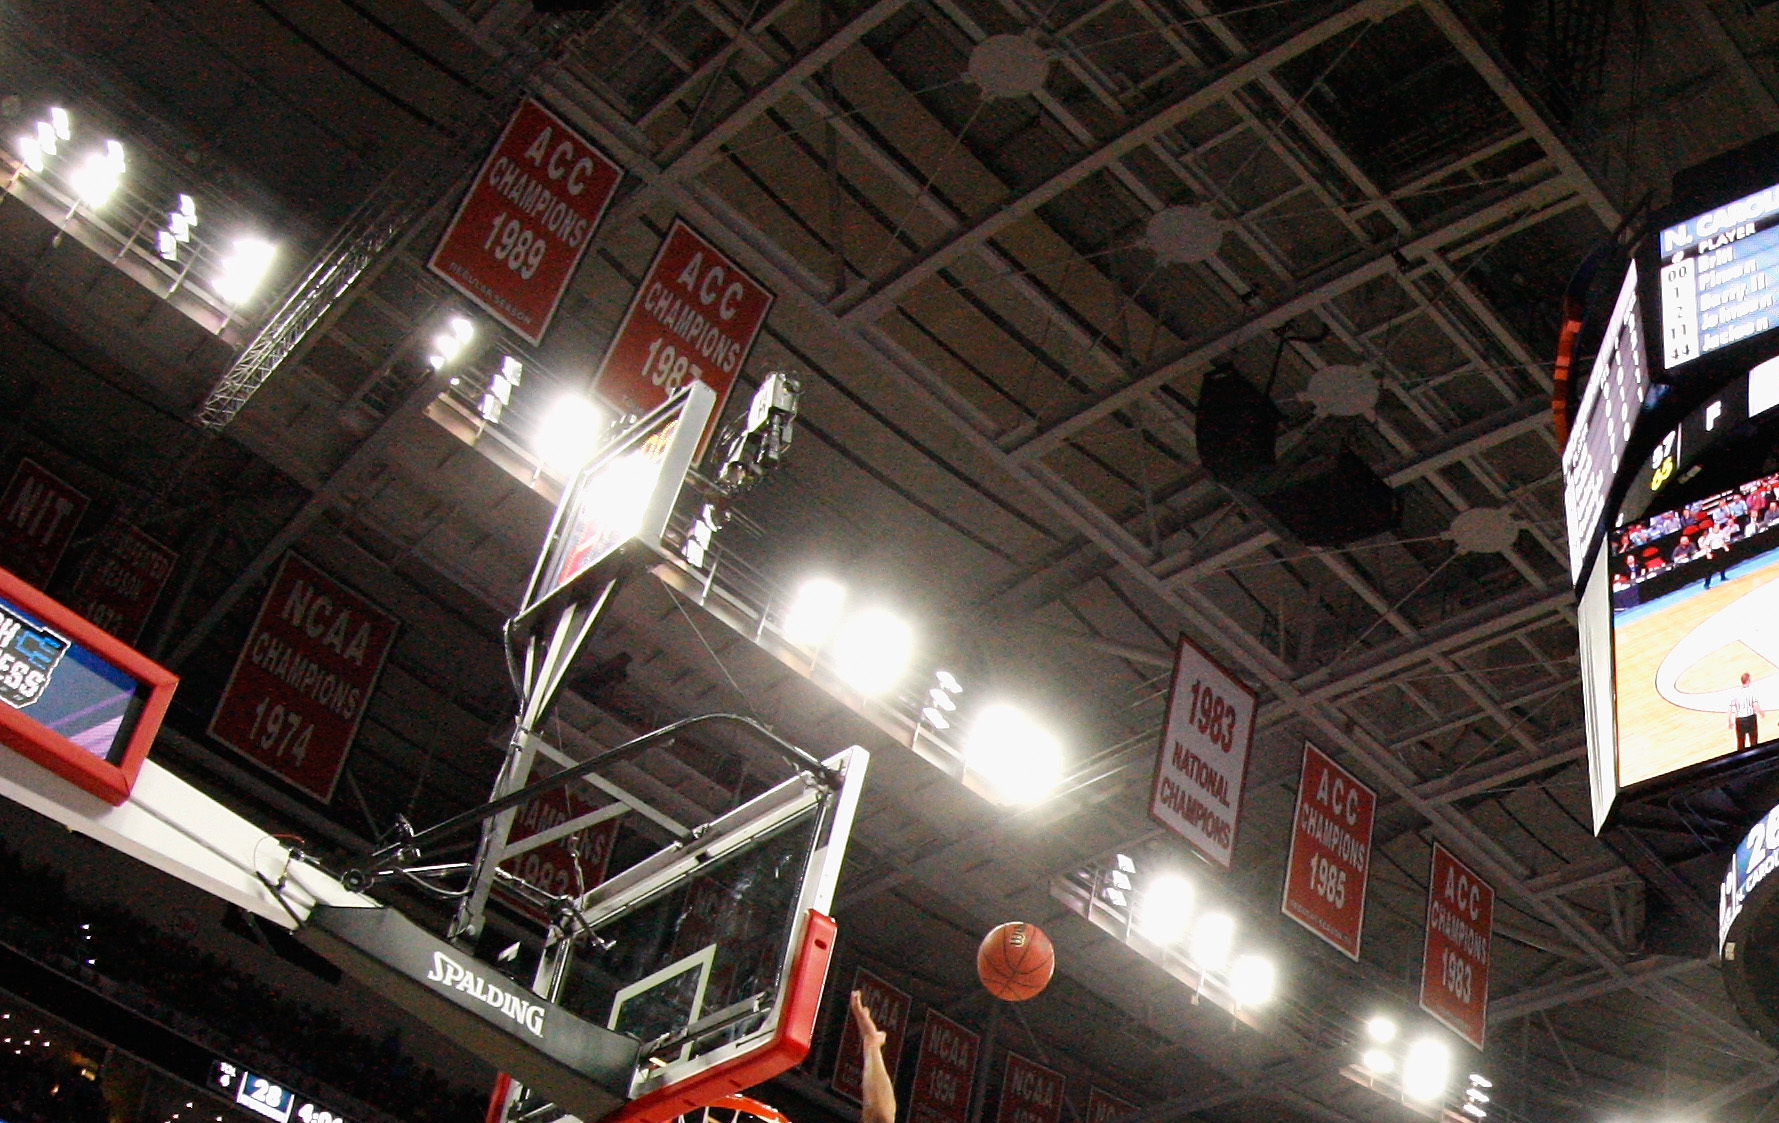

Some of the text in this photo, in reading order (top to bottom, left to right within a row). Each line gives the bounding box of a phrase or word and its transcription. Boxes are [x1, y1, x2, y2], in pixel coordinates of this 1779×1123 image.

[522, 125, 595, 197] ACC
[487, 155, 589, 249] CHAMPIONS
[483, 211, 547, 281] 1989
[1698, 222, 1757, 253] PLAYER
[675, 250, 744, 321] ACC
[1667, 266, 1688, 283] 00
[642, 280, 741, 374] CHAMPIONS
[281, 579, 374, 668] NCAA
[250, 632, 361, 720] CHAMPIONS
[249, 696, 315, 769] 1974
[1189, 677, 1237, 754] 1983
[1171, 740, 1231, 809] NATIONAL
[1315, 767, 1359, 827] ACC
[1159, 776, 1232, 851] CHAMPIONS
[1300, 805, 1366, 872] CHAMPIONS
[1310, 851, 1347, 910] 1985
[1443, 865, 1480, 922] ACC
[1431, 900, 1487, 966] CHAMPIONS
[428, 950, 546, 1038] SPALDING
[1440, 946, 1473, 1004] 1983
[251, 1078, 283, 1108] 28
